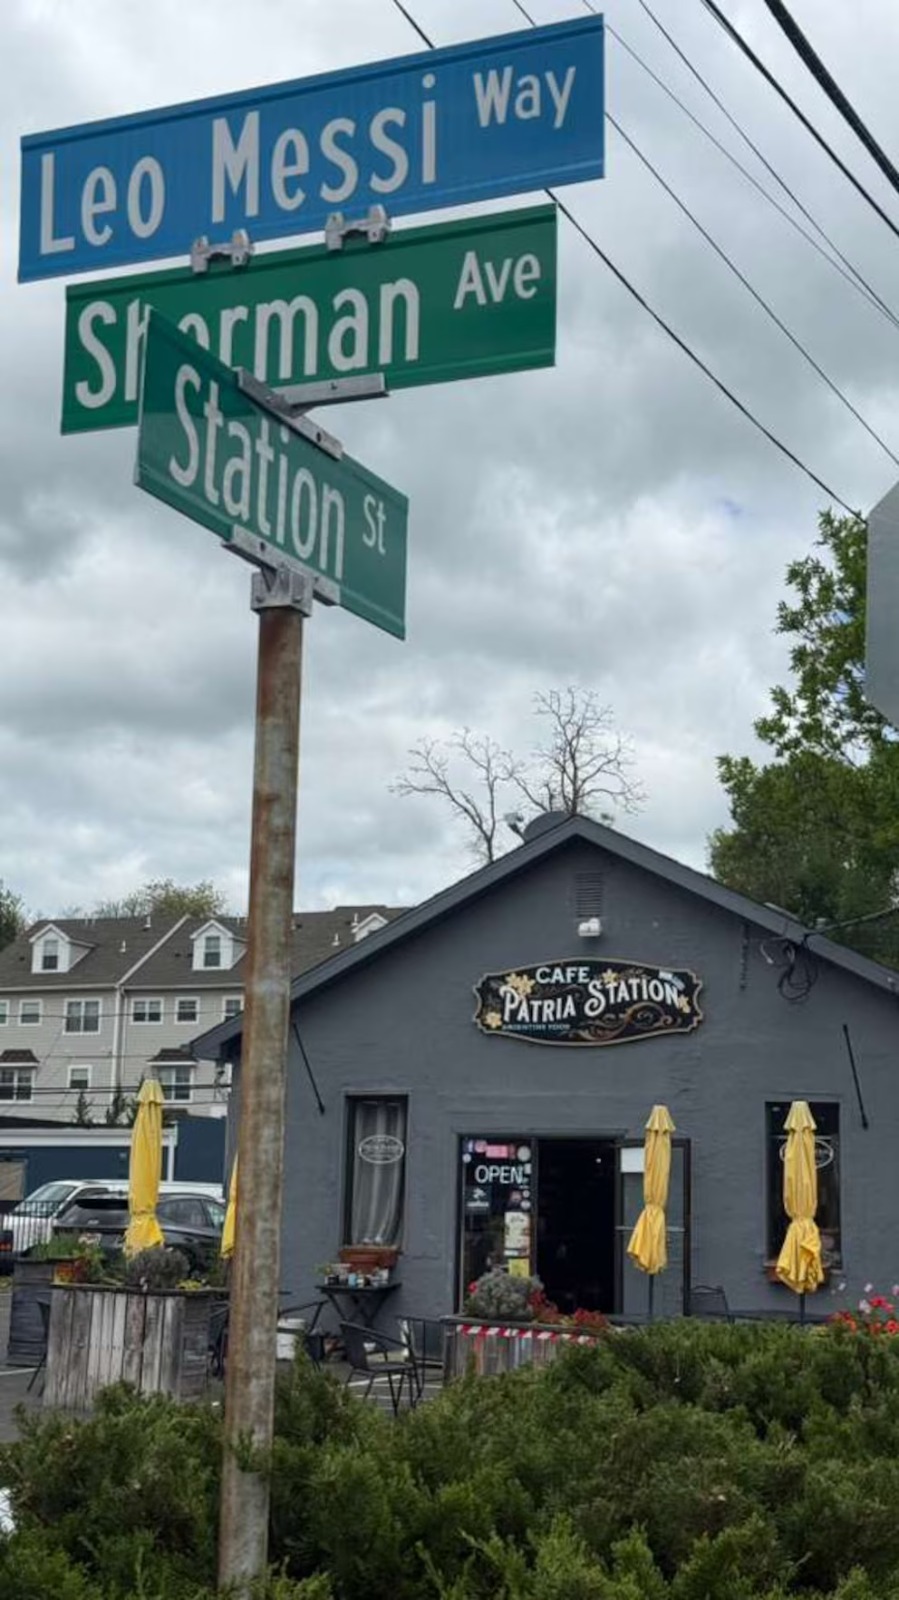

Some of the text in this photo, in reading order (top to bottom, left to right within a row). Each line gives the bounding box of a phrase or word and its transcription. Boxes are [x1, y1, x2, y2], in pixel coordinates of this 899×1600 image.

[40, 67, 576, 254] Leo Messi Way
[453, 251, 541, 309] Ave
[168, 364, 387, 578] Station St
[499, 985, 577, 1023] PATRIA
[584, 979, 679, 1017] STATION
[535, 967, 590, 984] CAFE
[475, 1165, 523, 1184] OPEN
